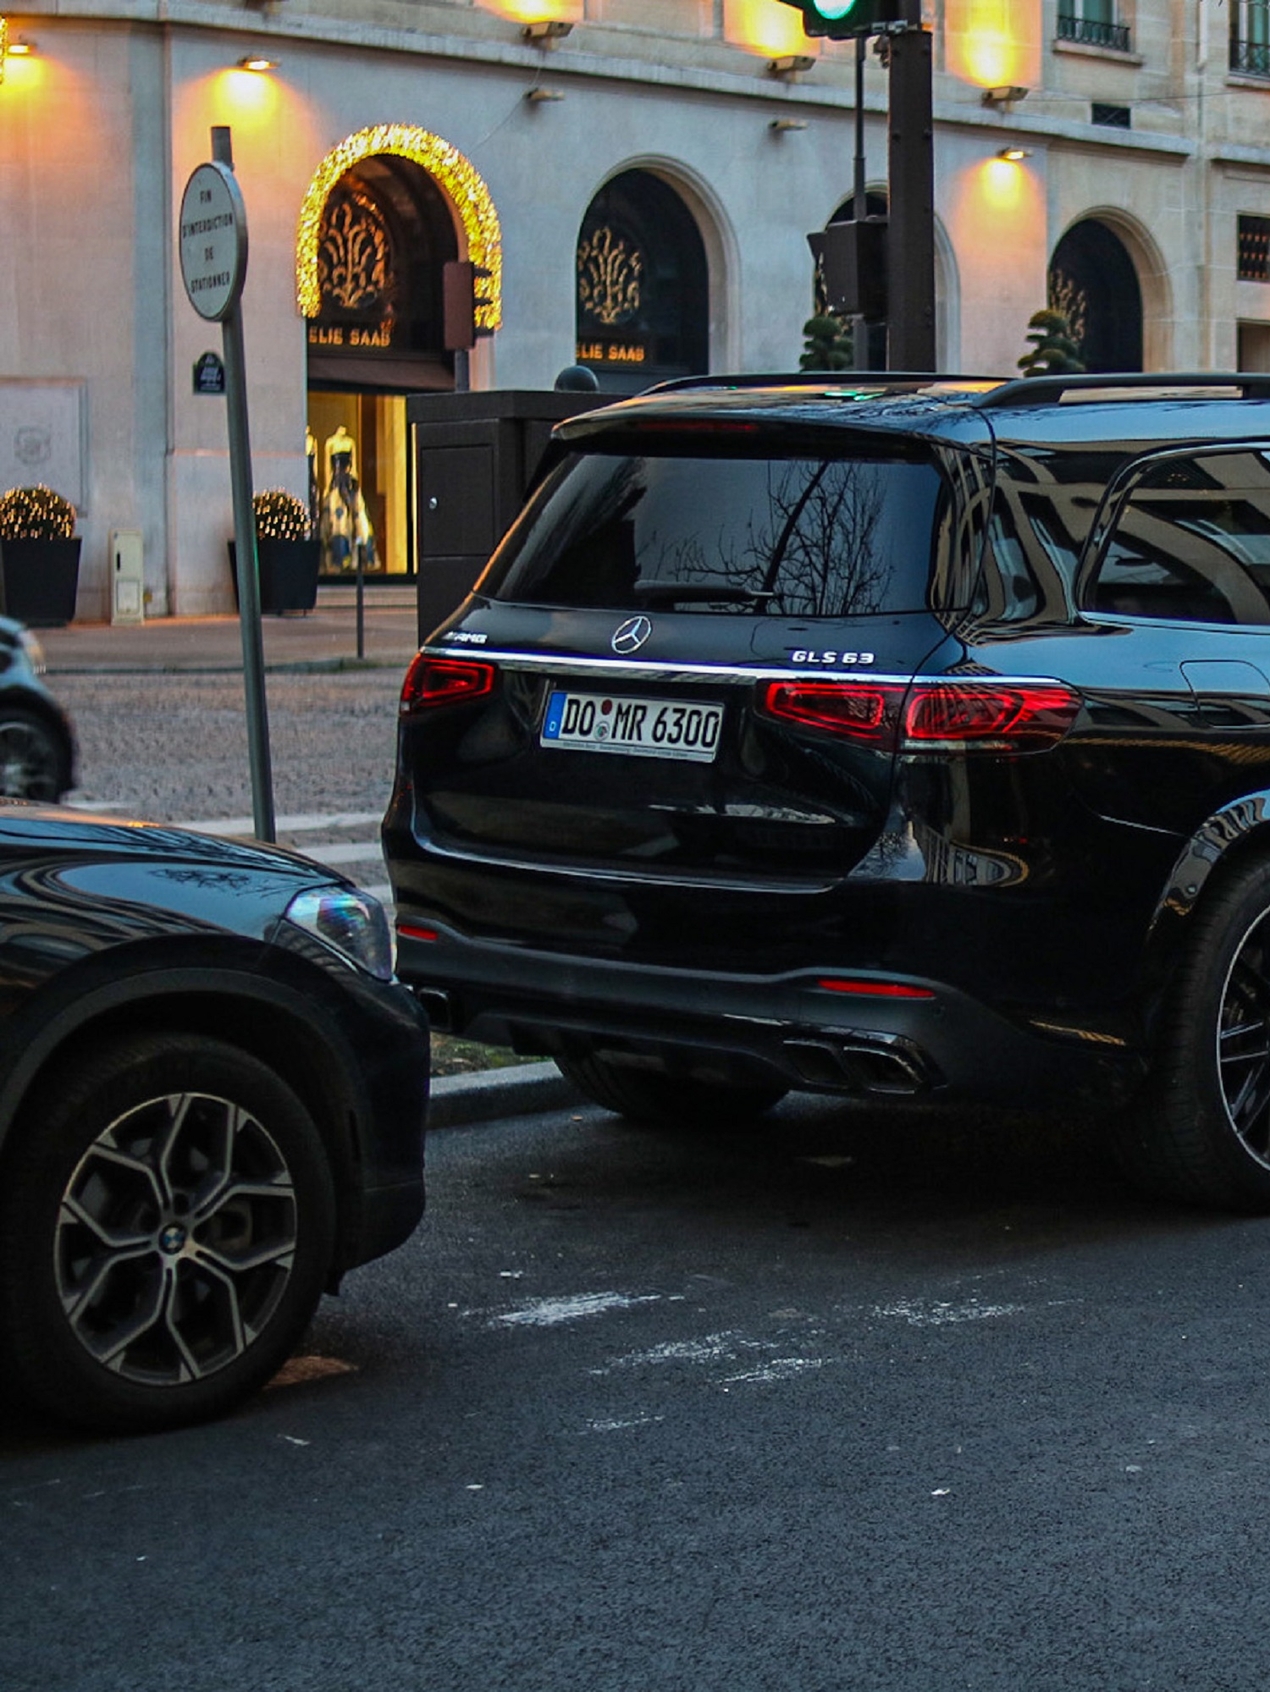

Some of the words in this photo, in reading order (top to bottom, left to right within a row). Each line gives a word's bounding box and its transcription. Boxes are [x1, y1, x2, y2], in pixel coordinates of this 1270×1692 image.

[200, 190, 212, 204] FIN
[204, 246, 214, 261] DE
[190, 271, 231, 294] STATIONNER
[309, 326, 343, 345] ELIE
[349, 328, 391, 347] SAAB
[608, 344, 645, 361] SAAB
[792, 650, 838, 664] GLS
[841, 652, 875, 664] 63
[561, 698, 596, 736] DO
[611, 703, 648, 742] MR
[652, 706, 720, 748] 6300
